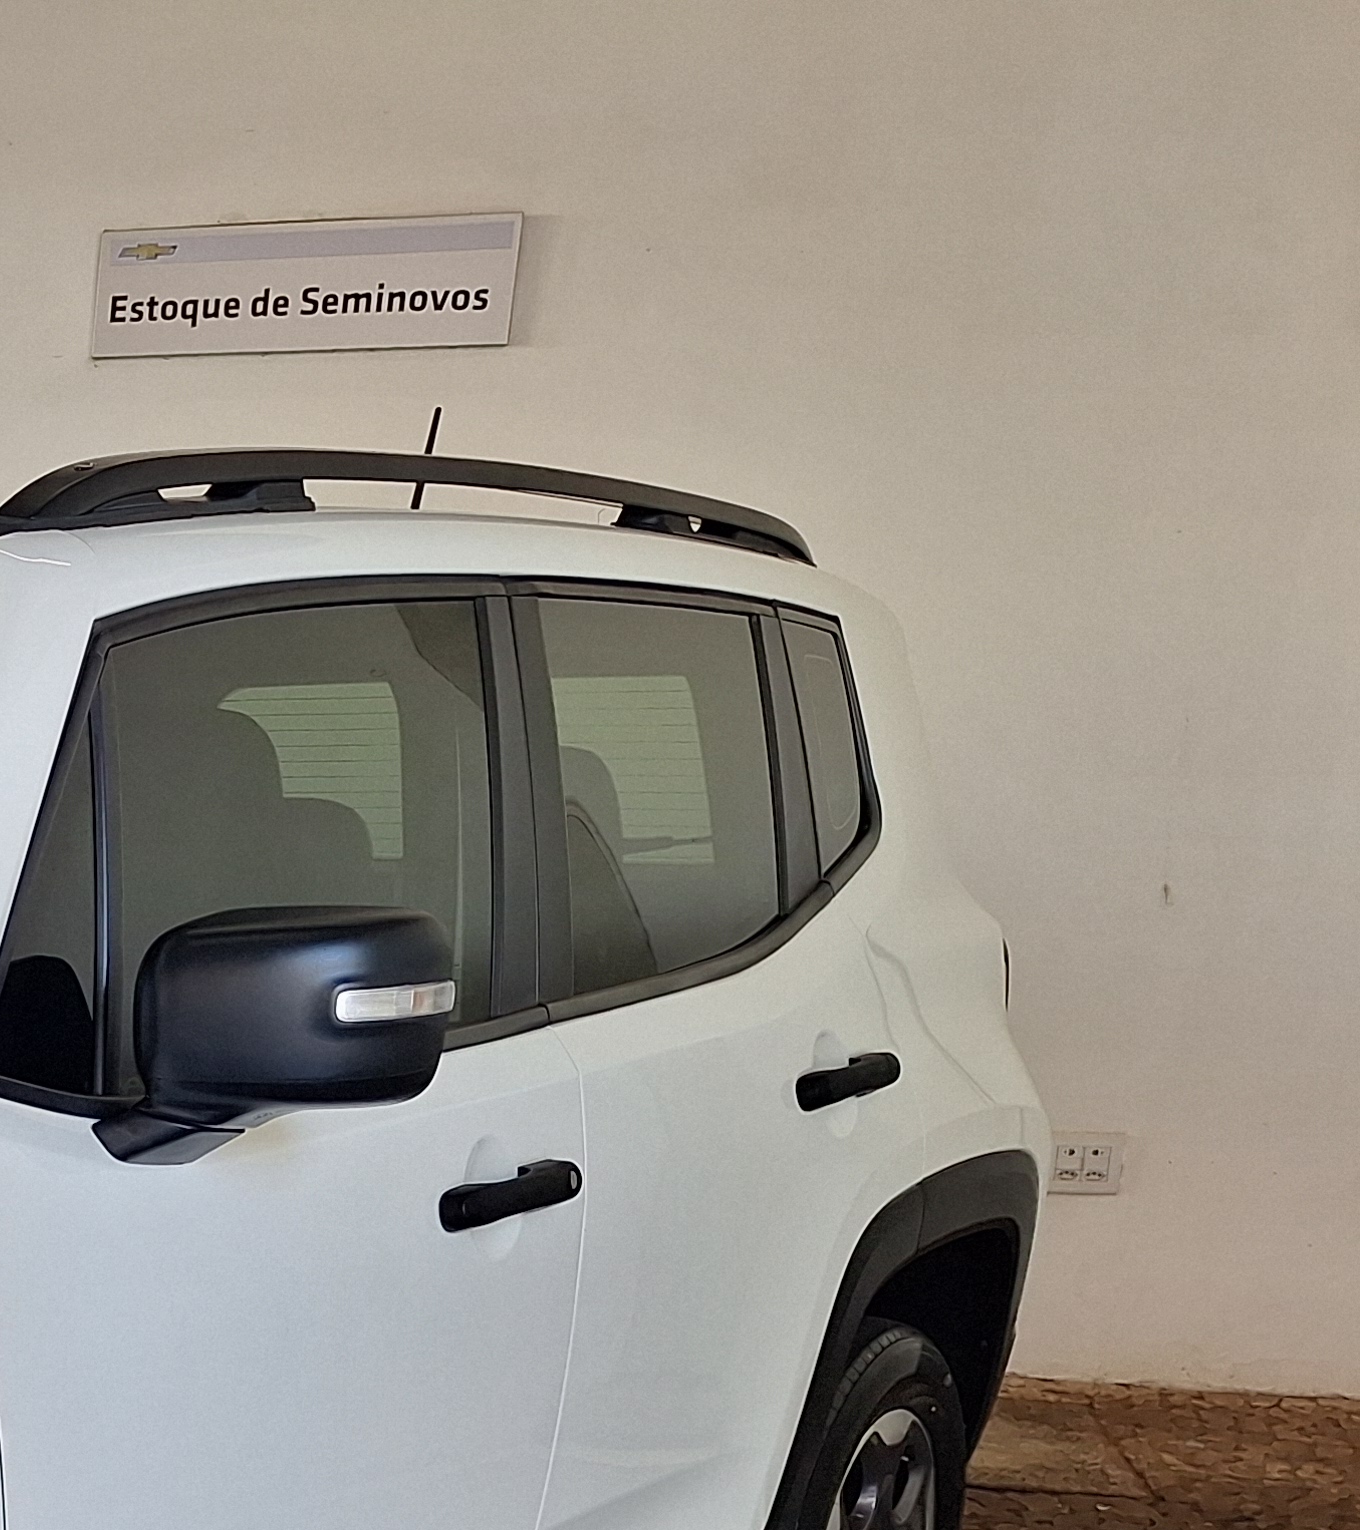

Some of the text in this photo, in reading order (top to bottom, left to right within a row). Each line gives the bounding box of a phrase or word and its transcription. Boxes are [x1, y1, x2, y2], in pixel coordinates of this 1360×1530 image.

[109, 282, 490, 328] Estoque de Seminovos
